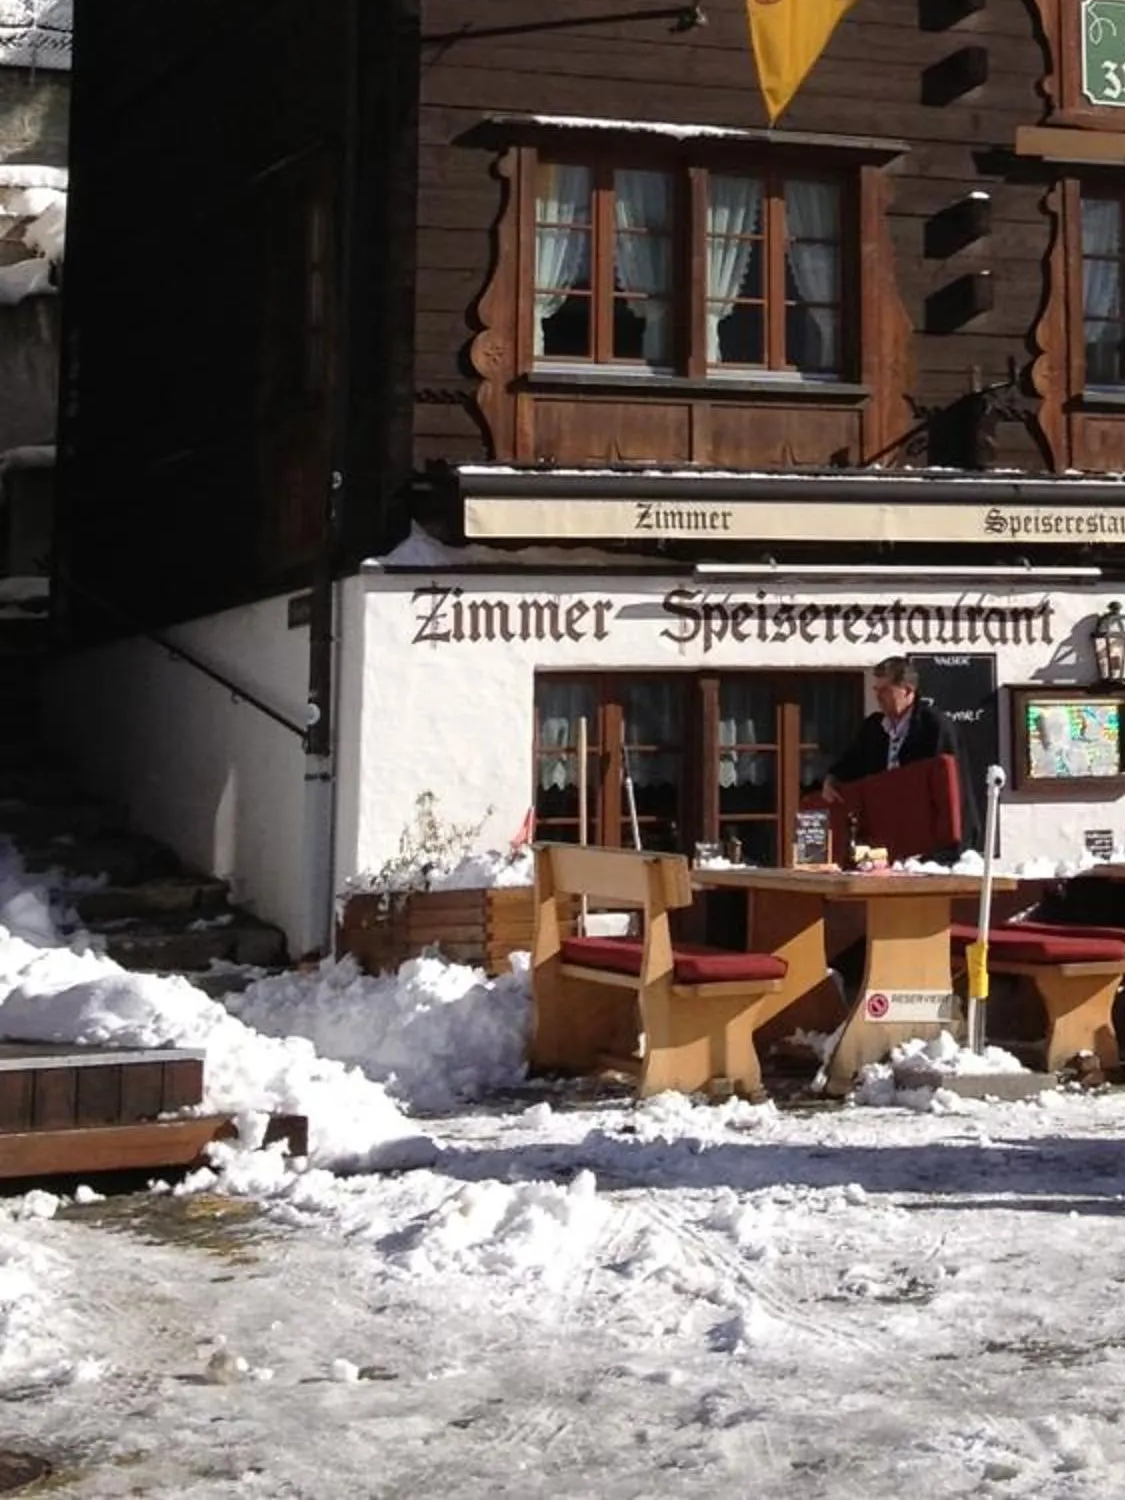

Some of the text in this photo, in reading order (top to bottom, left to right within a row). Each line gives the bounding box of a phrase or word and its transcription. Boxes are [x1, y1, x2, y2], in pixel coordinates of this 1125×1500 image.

[634, 503, 733, 532] Zimmer
[411, 585, 615, 647] Zimmer
[659, 584, 1059, 654] Speiserestaurant
